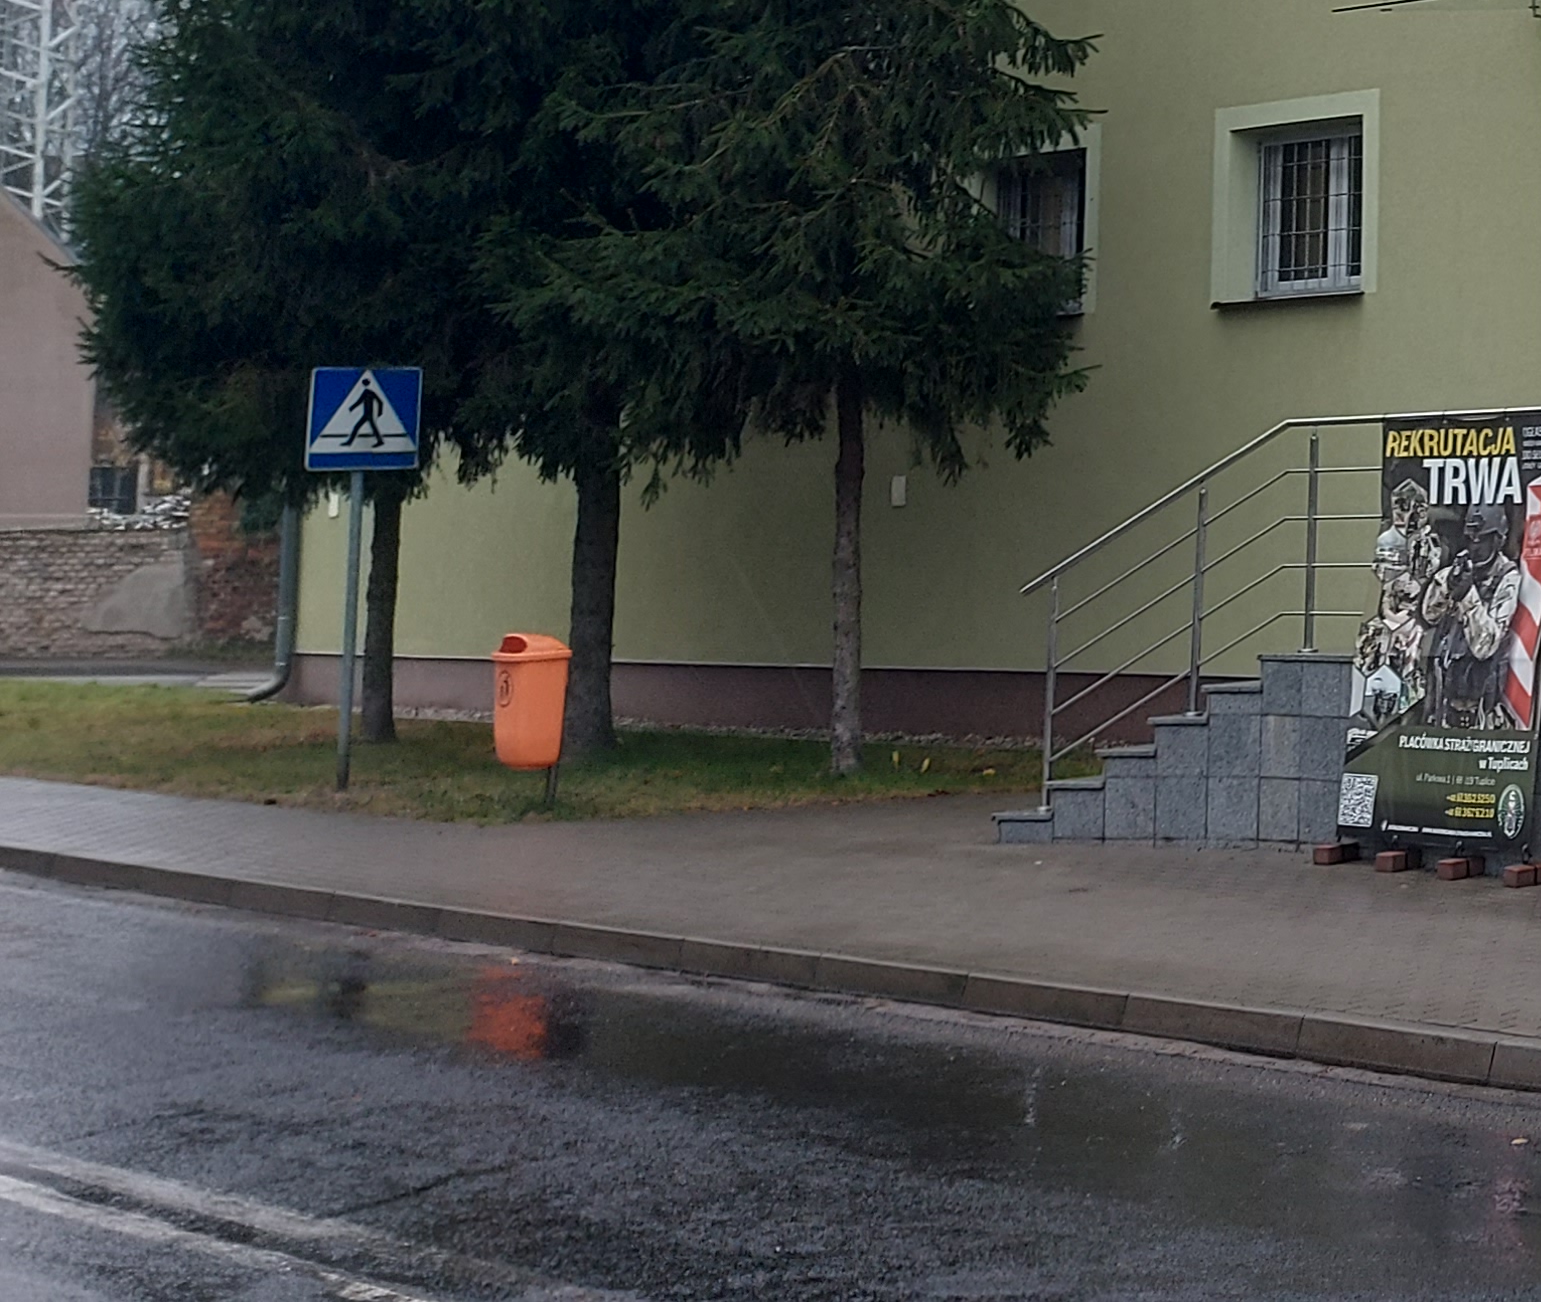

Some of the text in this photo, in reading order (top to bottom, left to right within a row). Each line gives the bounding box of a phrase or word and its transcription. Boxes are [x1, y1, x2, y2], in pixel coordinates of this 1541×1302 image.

[1386, 426, 1516, 458] REKRUTACJA
[1422, 456, 1523, 505] TRWA
[1399, 732, 1444, 750] PLACÓWKA
[1474, 738, 1531, 754] GRANICZNEJ
[1478, 756, 1529, 773] w Tuplicach
